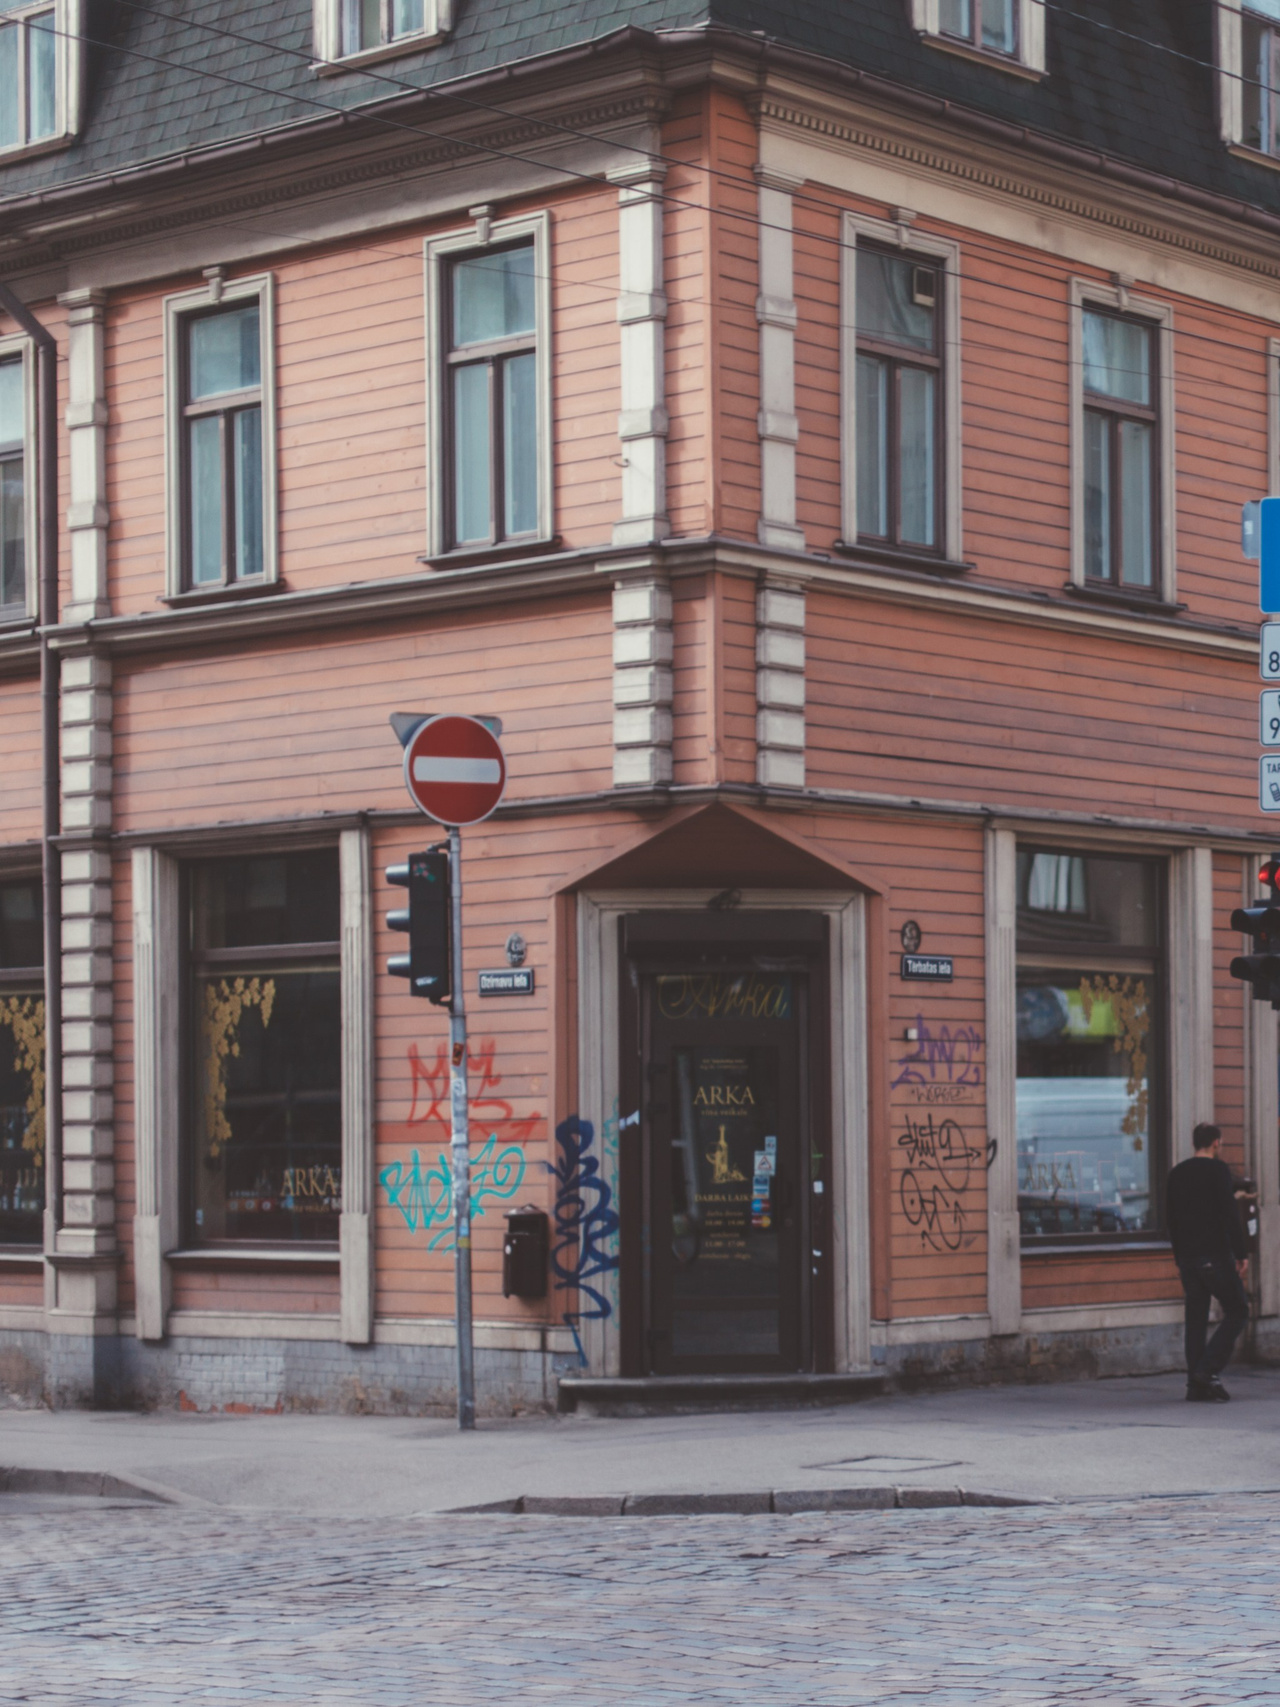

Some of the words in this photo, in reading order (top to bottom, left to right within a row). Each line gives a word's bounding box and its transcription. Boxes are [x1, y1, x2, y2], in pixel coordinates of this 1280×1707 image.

[938, 961, 951, 975] iela
[693, 1085, 756, 1105] ARKA
[279, 1167, 337, 1197] ARKA
[1022, 1161, 1077, 1191] ARKA
